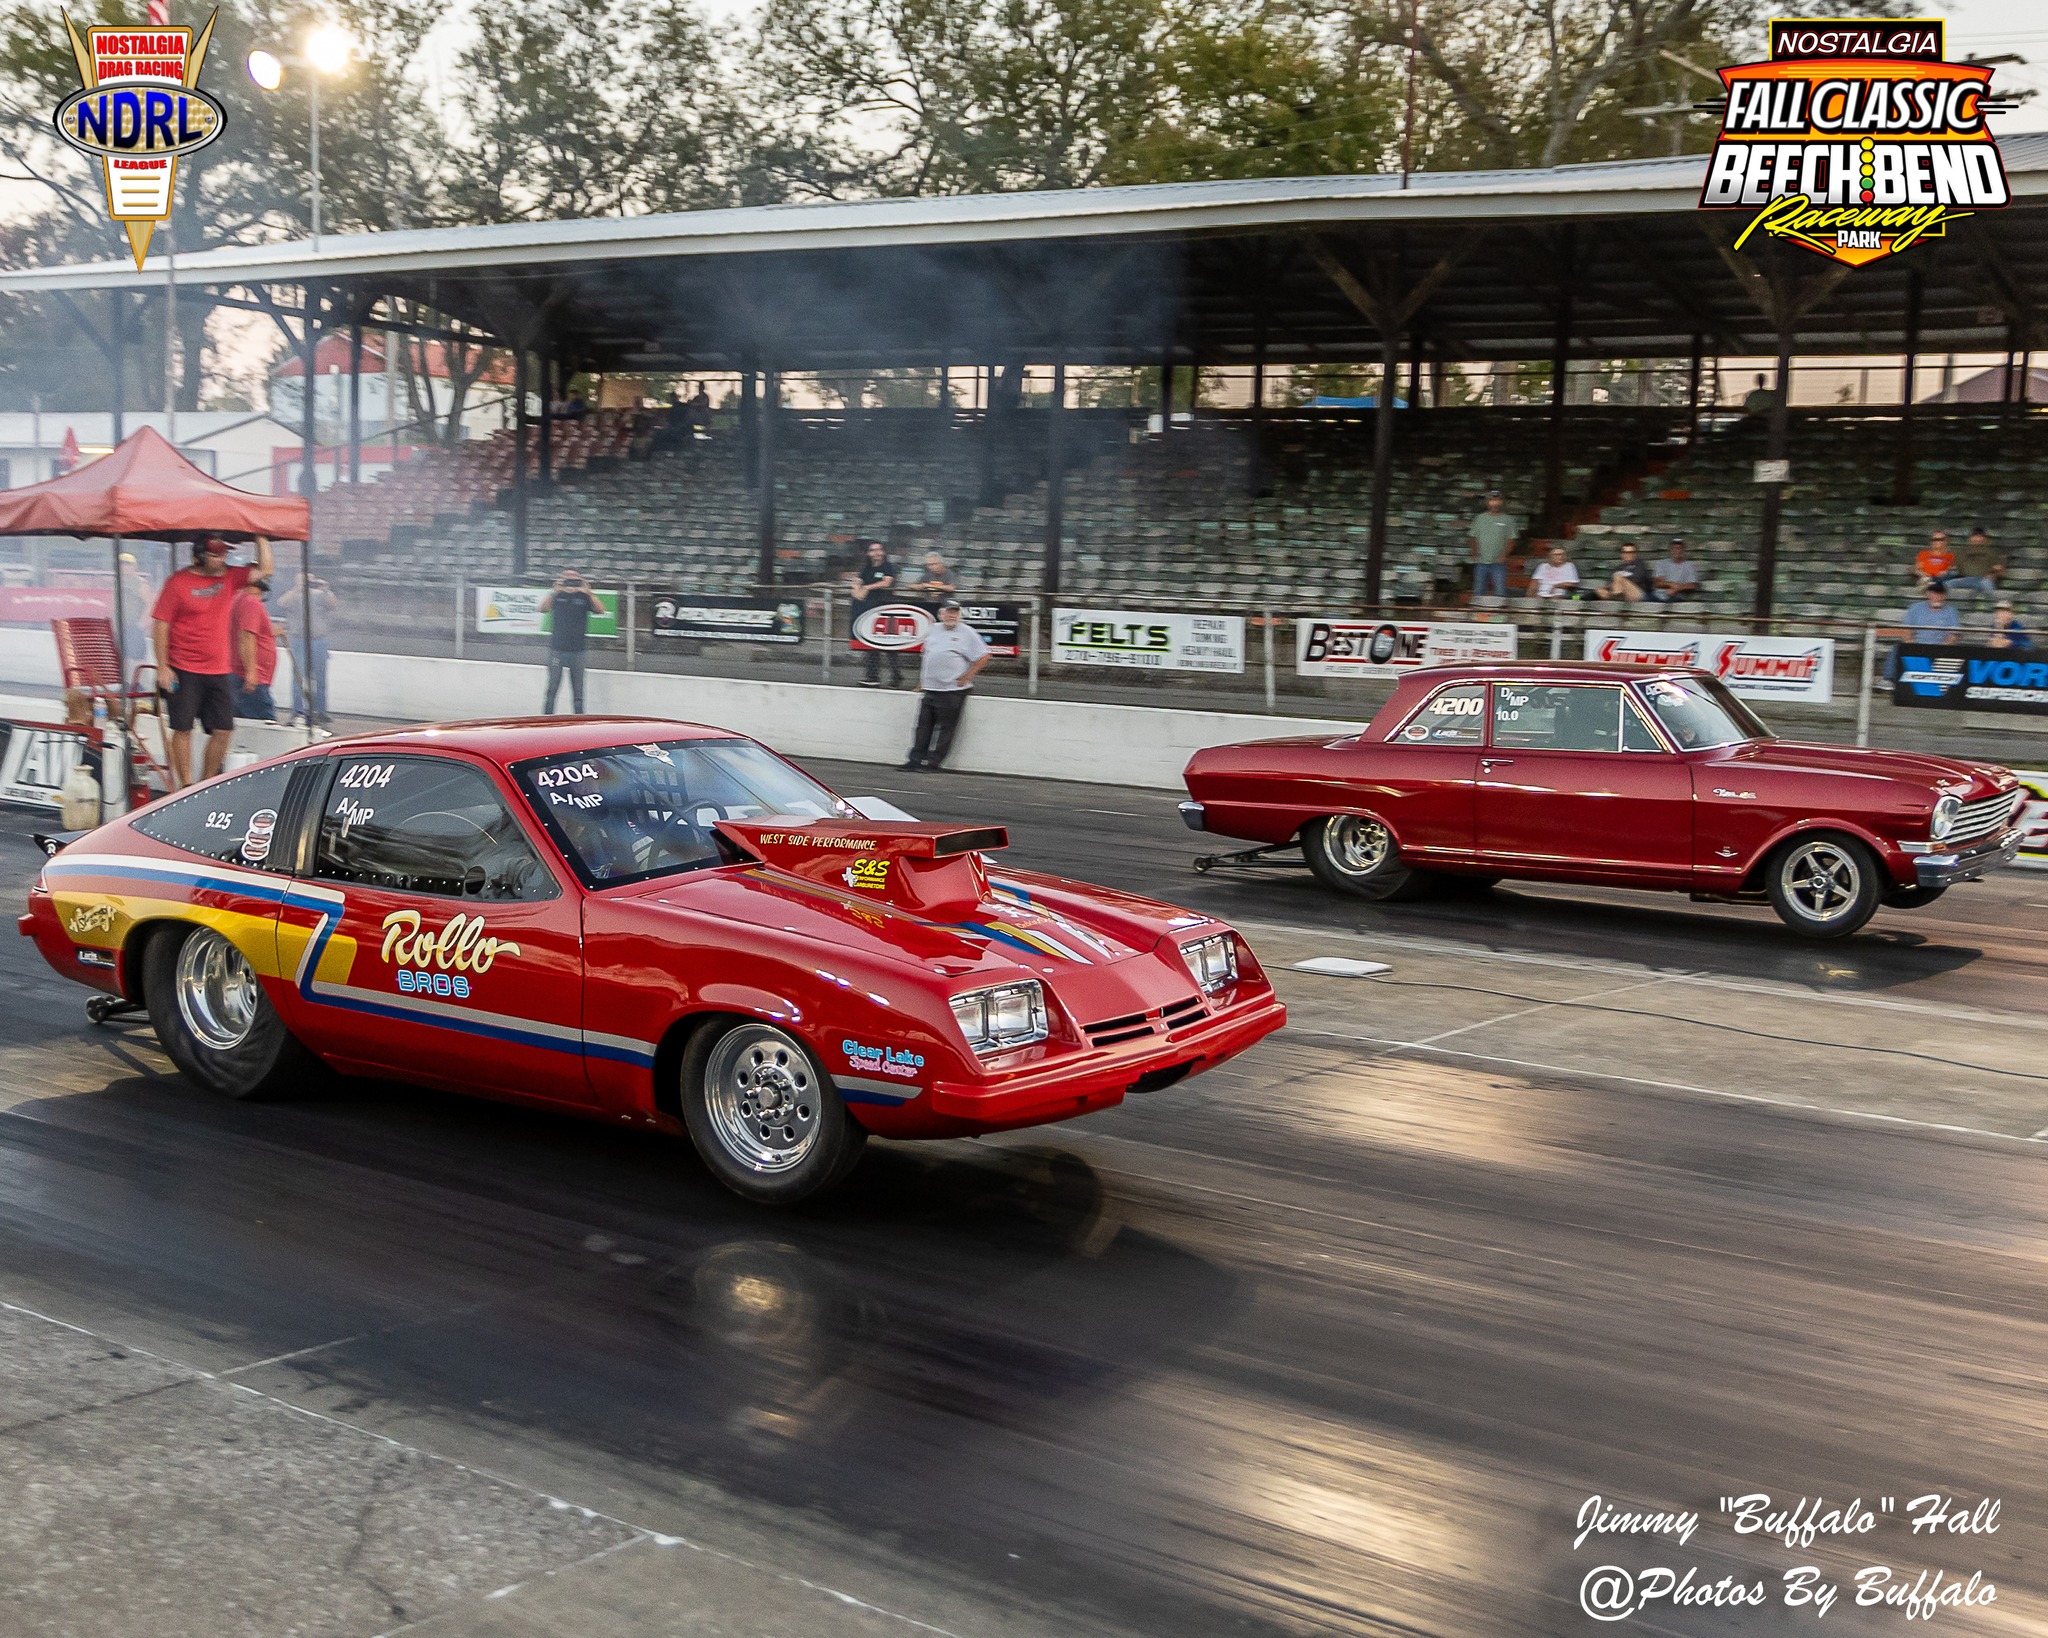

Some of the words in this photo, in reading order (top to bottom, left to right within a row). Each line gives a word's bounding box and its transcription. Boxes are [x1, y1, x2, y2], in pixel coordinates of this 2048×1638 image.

[1071, 621, 1171, 646] FELTS
[1429, 698, 1484, 715] 4200
[1501, 688, 1529, 706] D/MP
[1496, 711, 1519, 721] 10.0
[340, 765, 395, 788] 4204
[538, 764, 599, 787] 4204
[335, 797, 374, 825] A/MP
[550, 792, 603, 809] A/MP
[205, 812, 233, 829] 9.25
[760, 834, 785, 844] WEST
[788, 835, 810, 846] SIDE
[812, 837, 877, 850] PERFORMANCE
[852, 858, 890, 876] S&S
[381, 909, 521, 974] Rollo
[398, 969, 470, 998] BROS
[843, 1040, 883, 1058] Clear
[886, 1047, 924, 1067] Lake
[849, 1056, 881, 1071] Speed
[882, 1061, 918, 1078] Center
